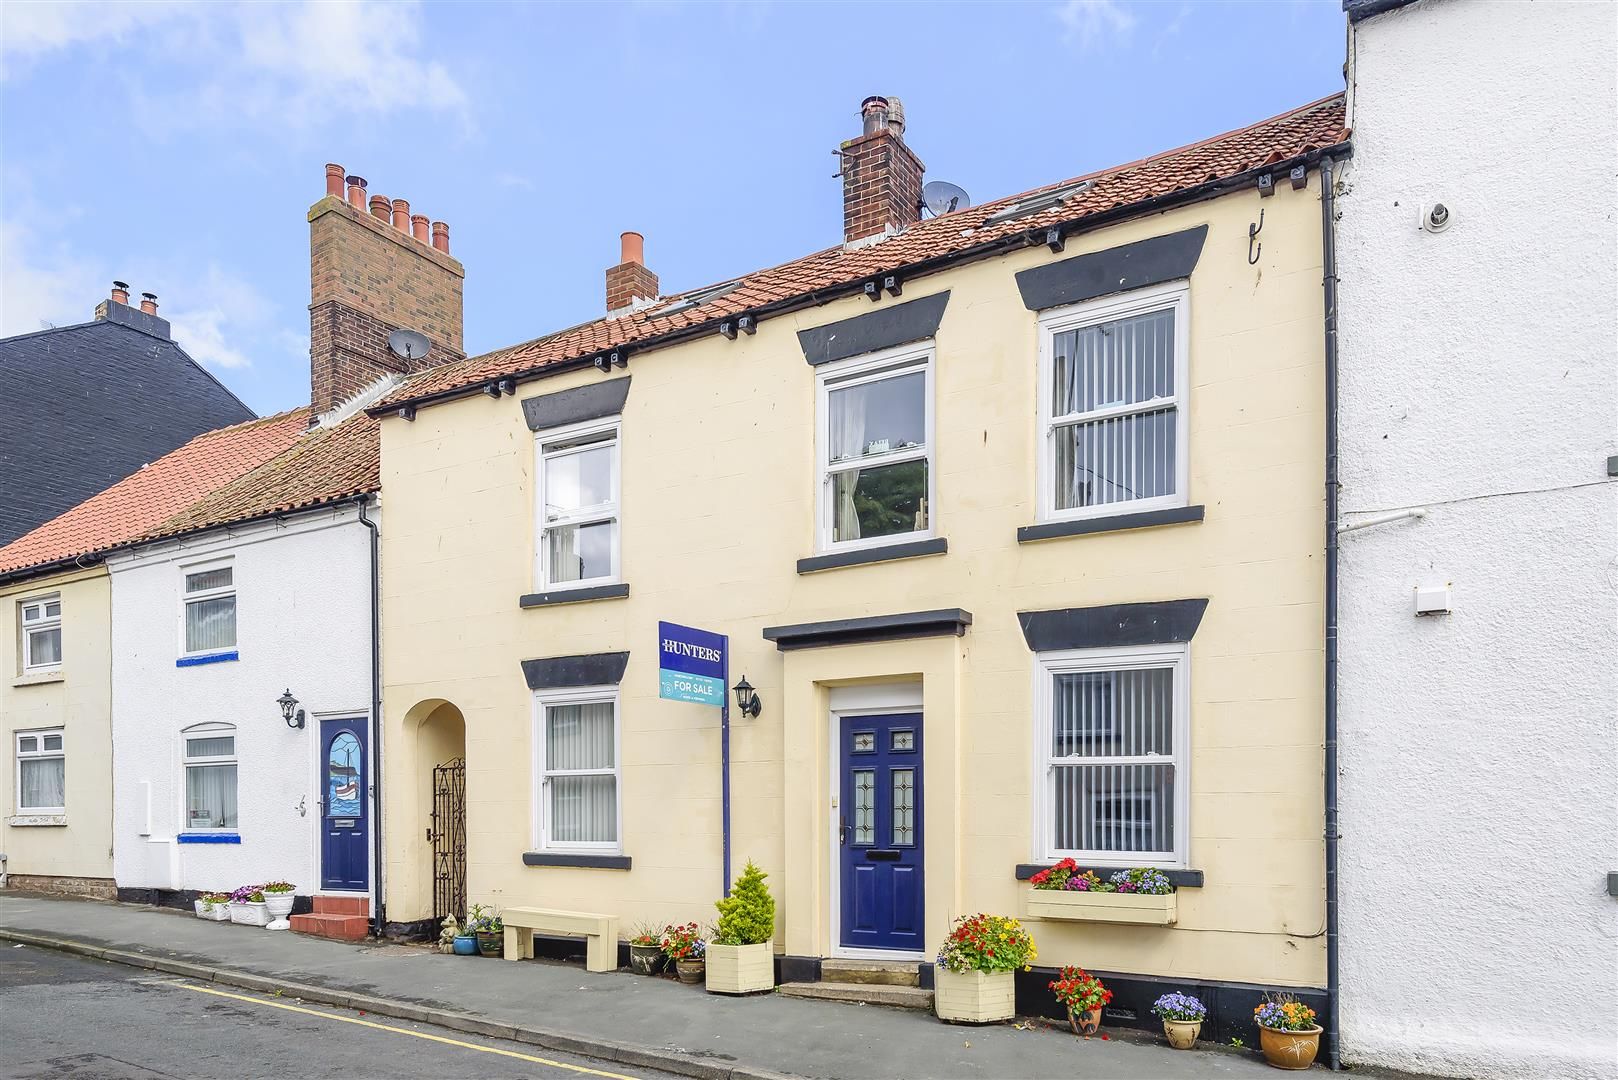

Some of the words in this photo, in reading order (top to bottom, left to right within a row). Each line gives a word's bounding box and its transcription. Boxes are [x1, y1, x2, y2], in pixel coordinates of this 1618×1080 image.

[662, 639, 721, 662] HUNTERS
[674, 681, 691, 692] FOR
[693, 684, 713, 696] SALE
